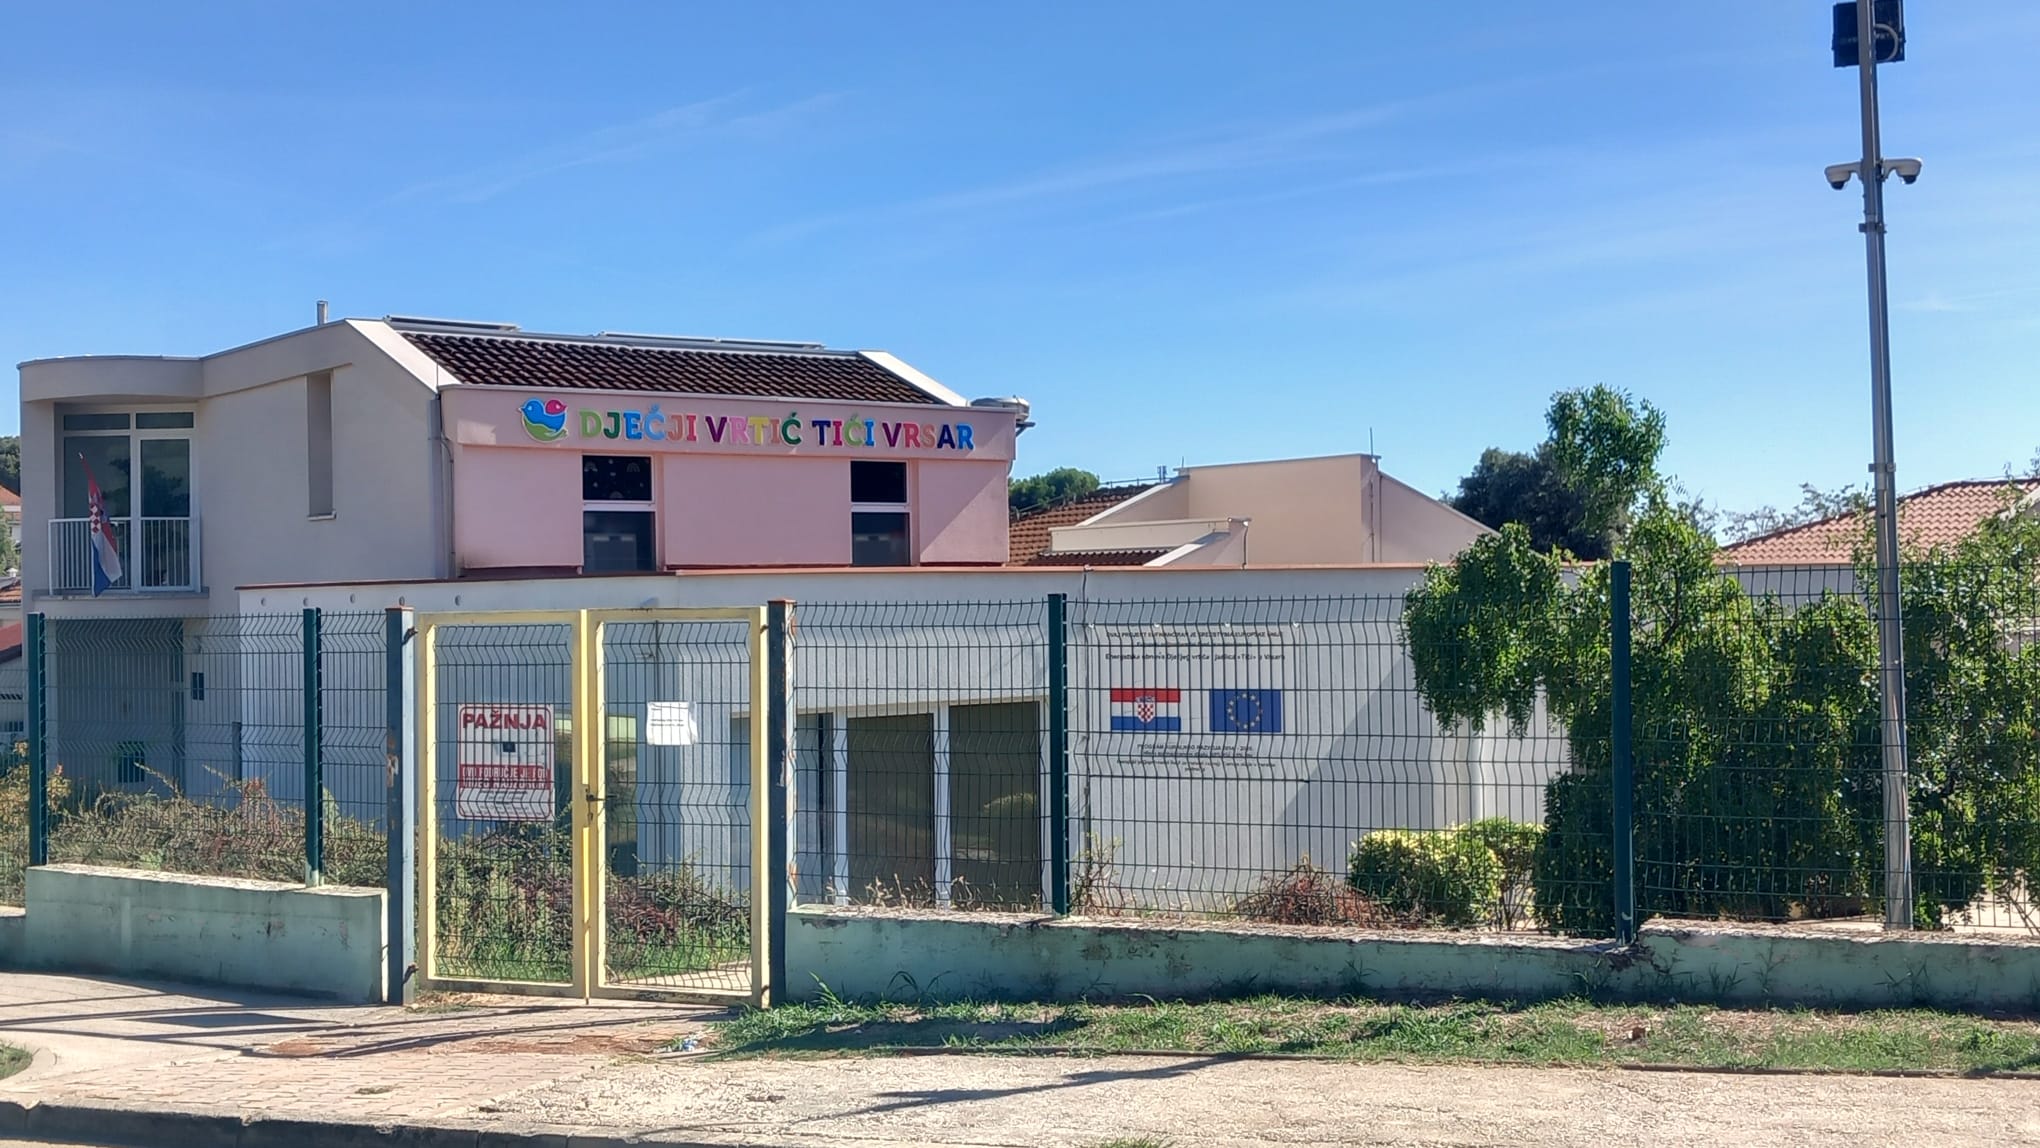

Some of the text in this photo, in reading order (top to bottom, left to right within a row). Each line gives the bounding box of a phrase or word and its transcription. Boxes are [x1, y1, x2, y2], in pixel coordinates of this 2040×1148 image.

[579, 404, 974, 450] DJEČJI VRTIĆ TIĆI VRSAR
[463, 709, 547, 730] PAŽNJA
